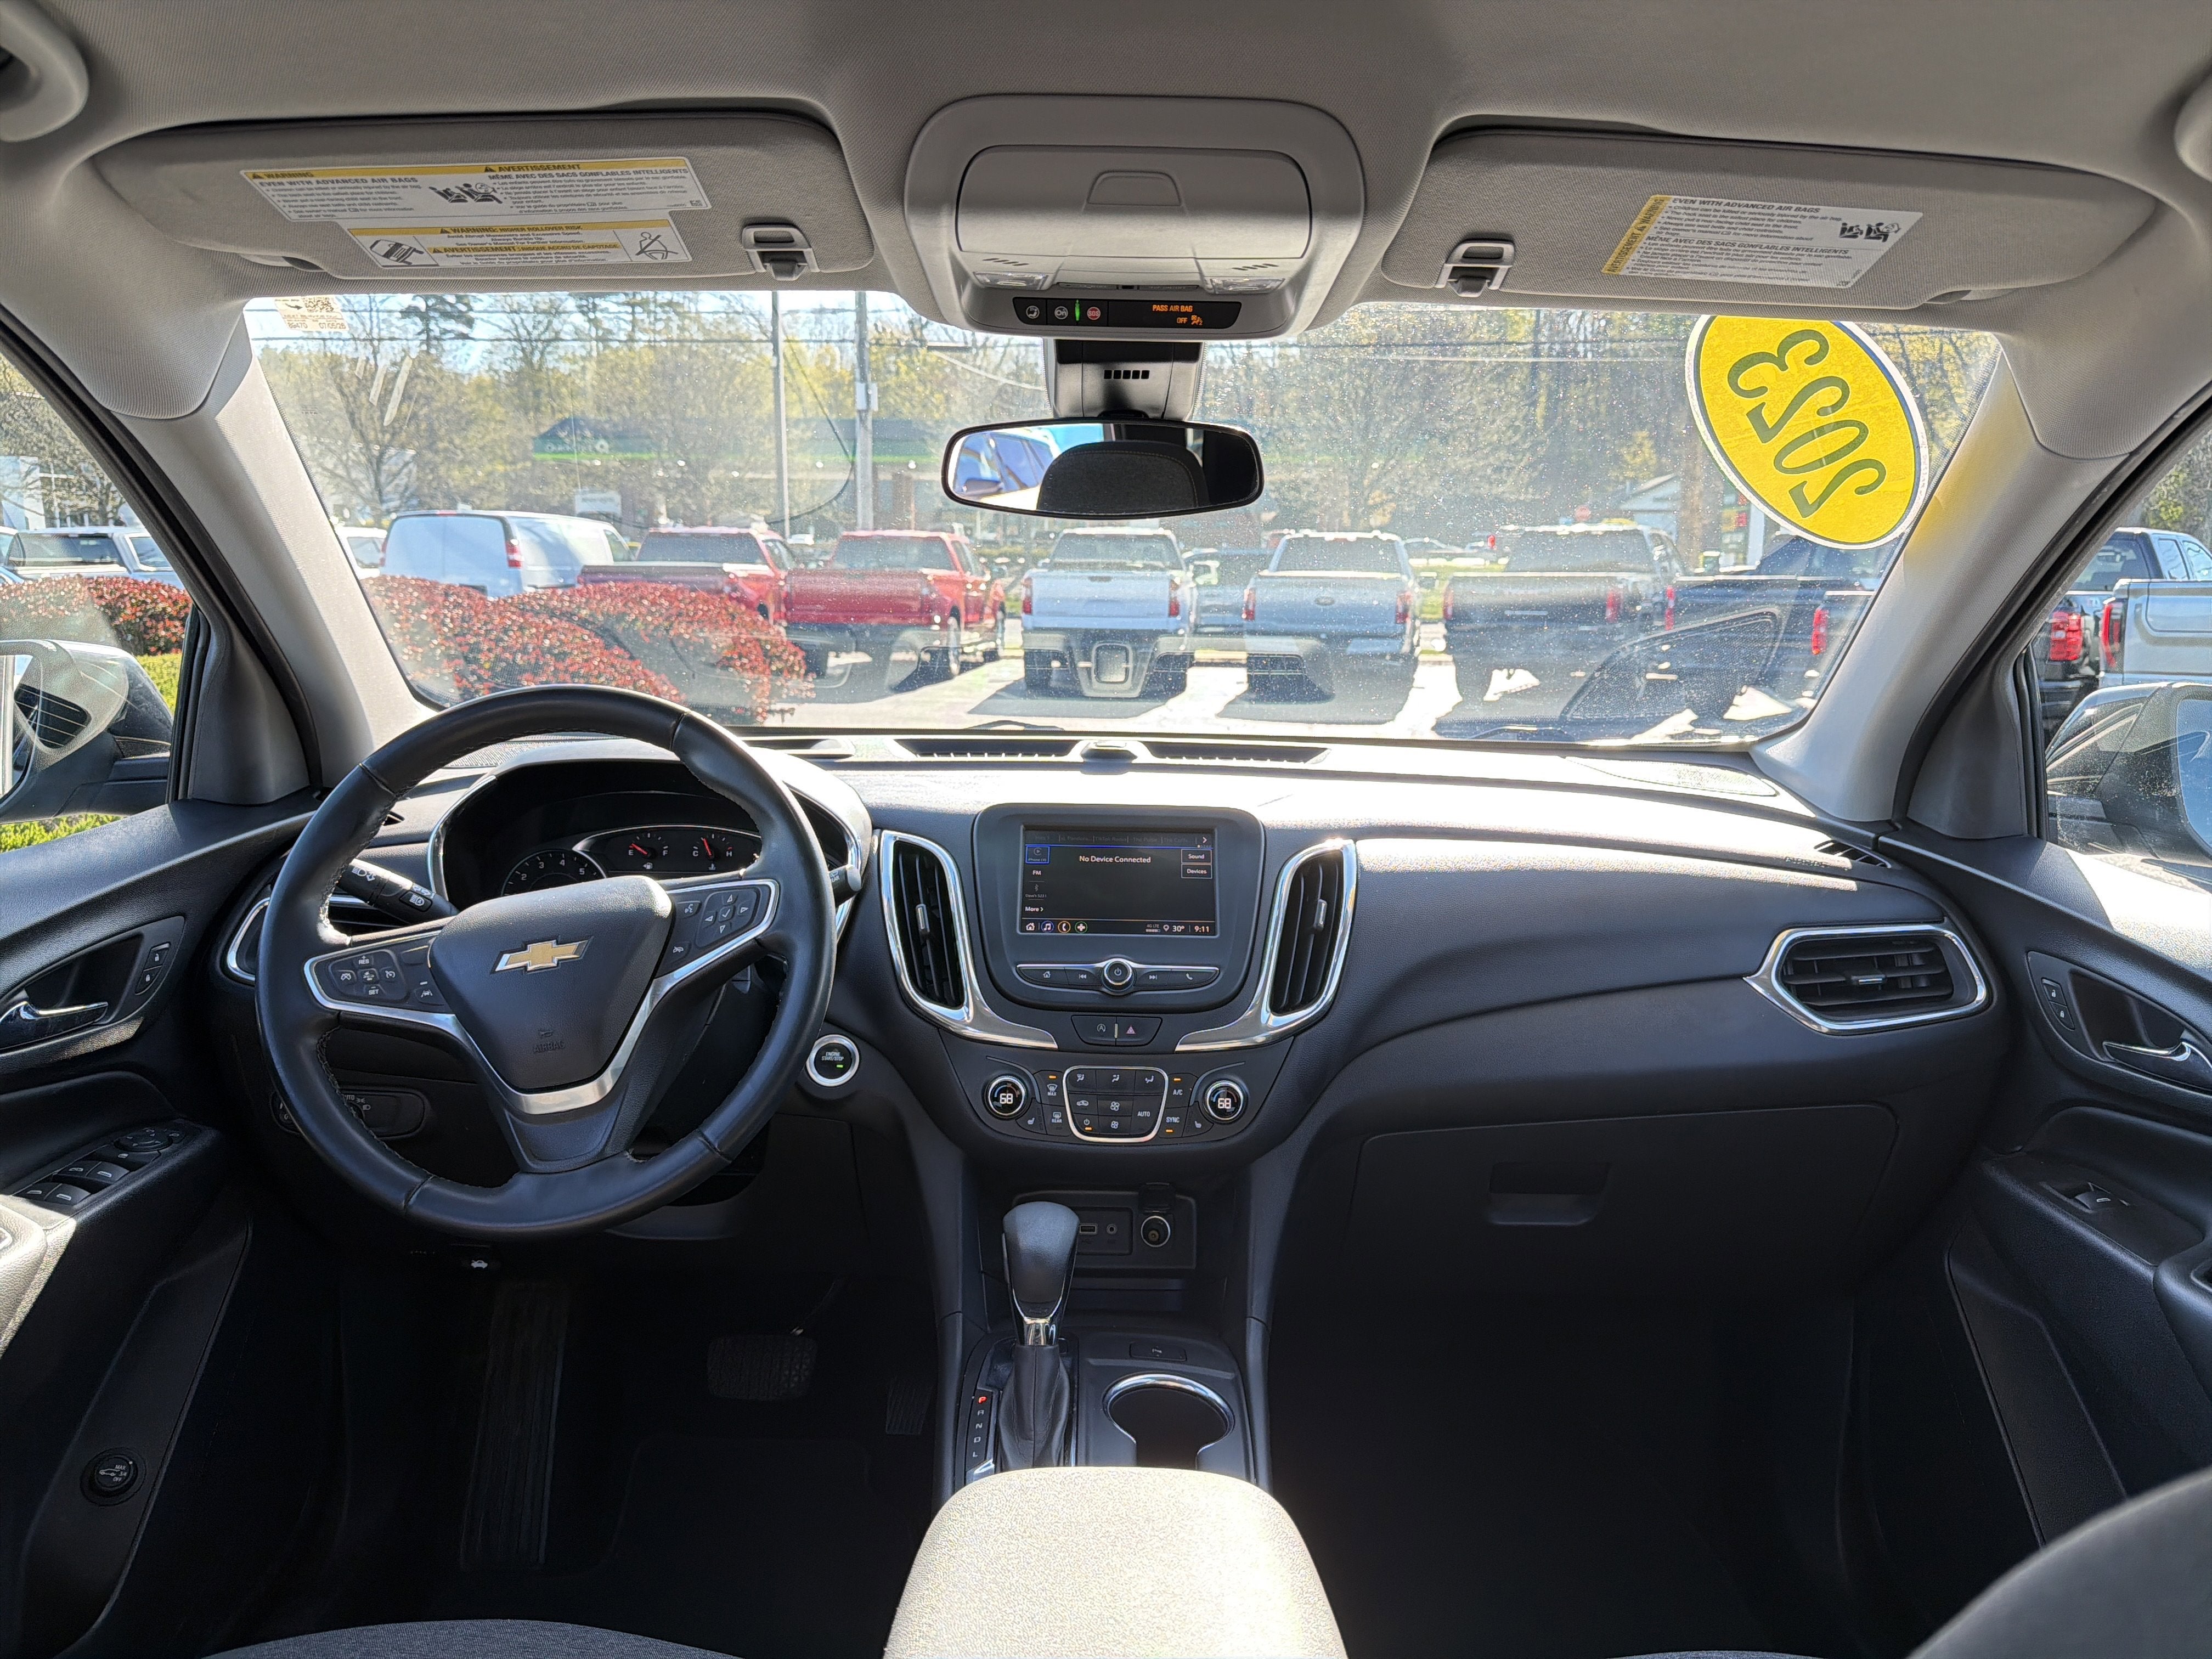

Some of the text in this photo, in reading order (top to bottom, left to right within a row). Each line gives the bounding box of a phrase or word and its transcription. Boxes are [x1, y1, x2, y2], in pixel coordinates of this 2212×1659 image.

[1723, 201, 1774, 210] ADVANCED
[1640, 199, 1664, 224] WARNING
[1646, 235, 1671, 243] MÊME
[1737, 242, 1790, 250] GONFLABLES
[1792, 245, 1849, 254] INTELLIGENTS
[1607, 232, 1641, 273] AVERTISSEMENT
[1152, 304, 1193, 313] PASS AIR BAG
[533, 1040, 566, 1054] AIRBAG
[1000, 1093, 1013, 1104] 68
[1217, 1098, 1231, 1109] 68
[978, 1396, 987, 1404] P
